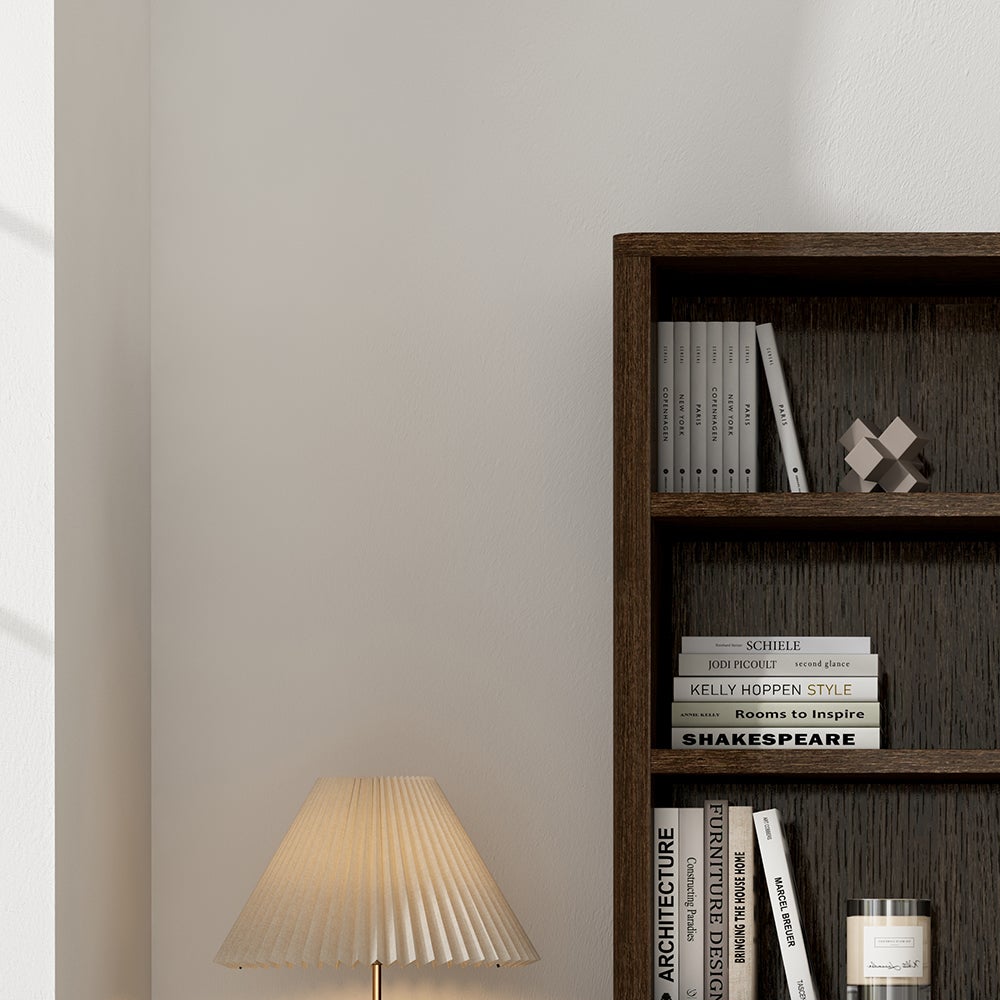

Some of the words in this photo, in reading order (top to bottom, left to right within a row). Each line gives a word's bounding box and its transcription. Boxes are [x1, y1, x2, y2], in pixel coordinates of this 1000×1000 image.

[778, 404, 788, 426] PARIS
[746, 640, 801, 651] SCHIELE
[708, 660, 730, 670] JODI
[733, 660, 777, 669] PICOULT
[795, 660, 822, 668] second
[824, 660, 850, 669] glance
[690, 684, 736, 695] KELLY
[741, 684, 801, 695] HOPPEN
[807, 684, 852, 695] STYLE
[735, 709, 787, 719] Rooms
[791, 710, 808, 719] to
[812, 709, 865, 721] Inspire
[682, 733, 856, 746] SHAKESPEARE
[709, 804, 723, 925] FURNITURE
[734, 851, 745, 874] HOME
[684, 857, 697, 907] Constructing
[734, 877, 745, 904] HOUSE
[658, 827, 674, 982] ARCHITECTURE
[734, 906, 745, 922] THE
[774, 877, 787, 911] MARCEL
[782, 913, 795, 947] BREUER
[734, 924, 745, 963] BRINGING
